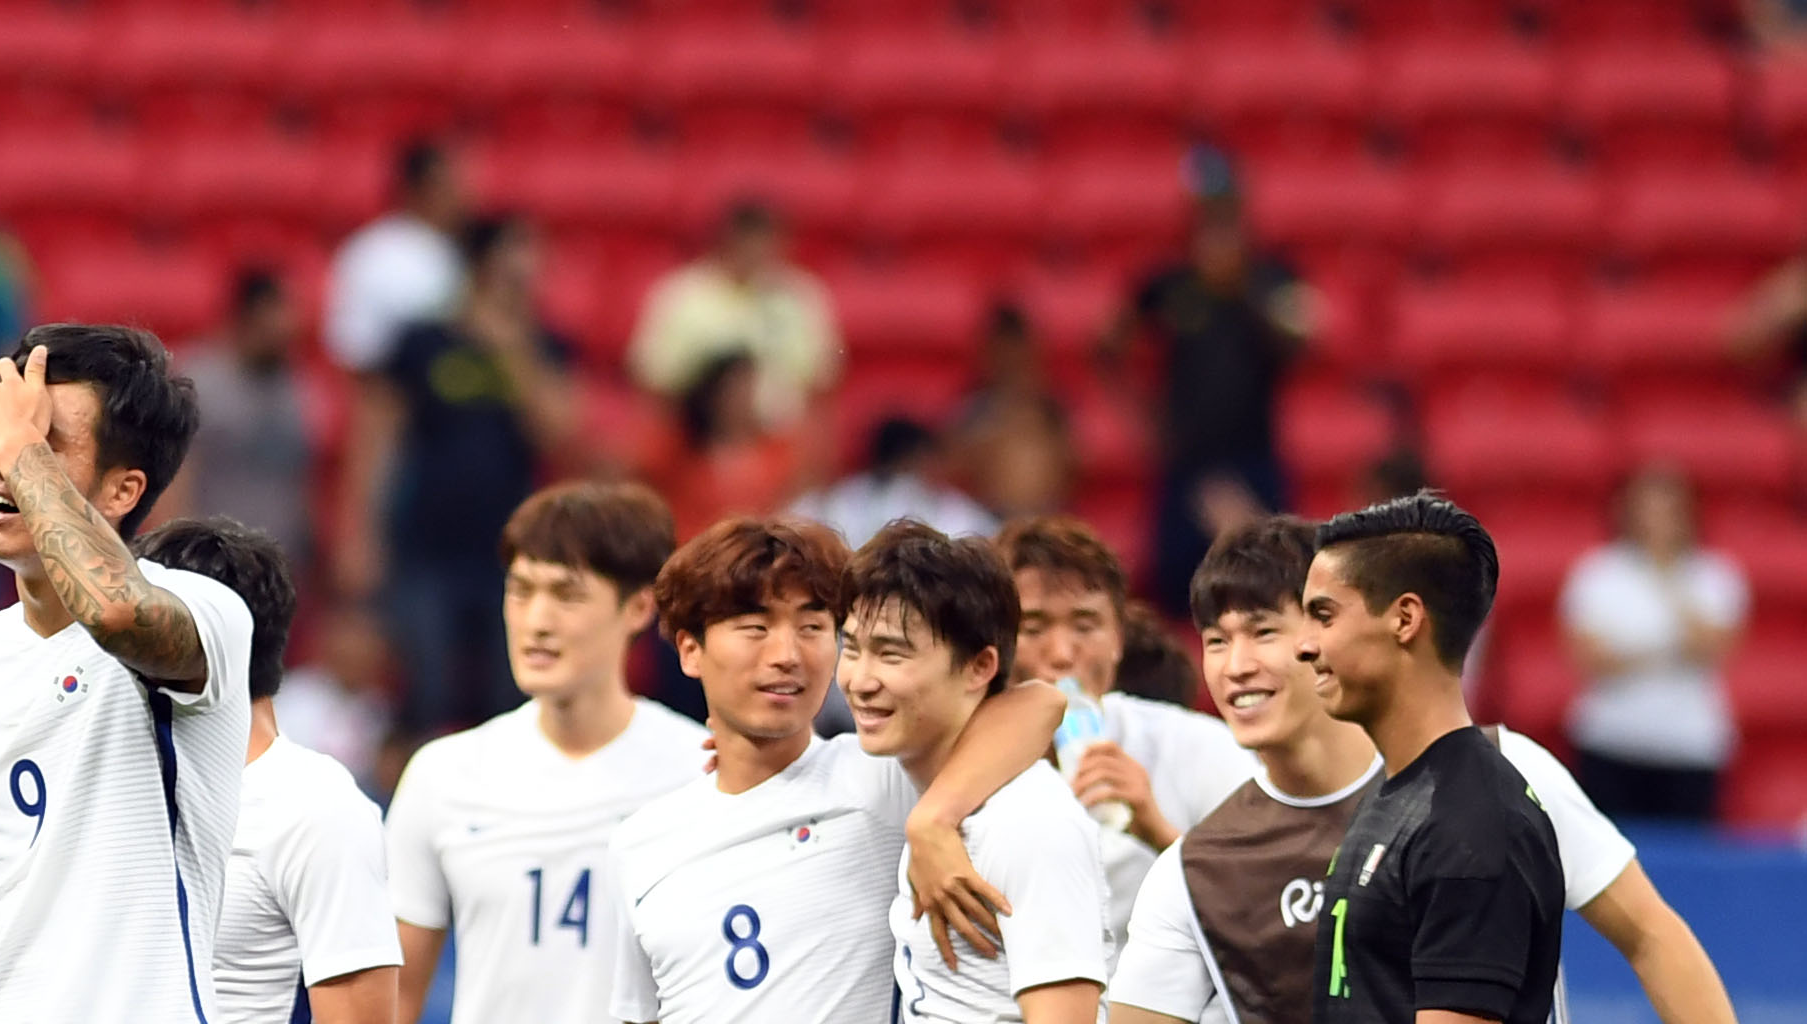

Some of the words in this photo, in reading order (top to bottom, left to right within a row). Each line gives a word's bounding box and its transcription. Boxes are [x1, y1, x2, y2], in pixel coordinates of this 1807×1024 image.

[8, 758, 48, 849] 9
[524, 868, 591, 948] 14
[721, 903, 771, 991] 8
[1329, 898, 1351, 999] 1
